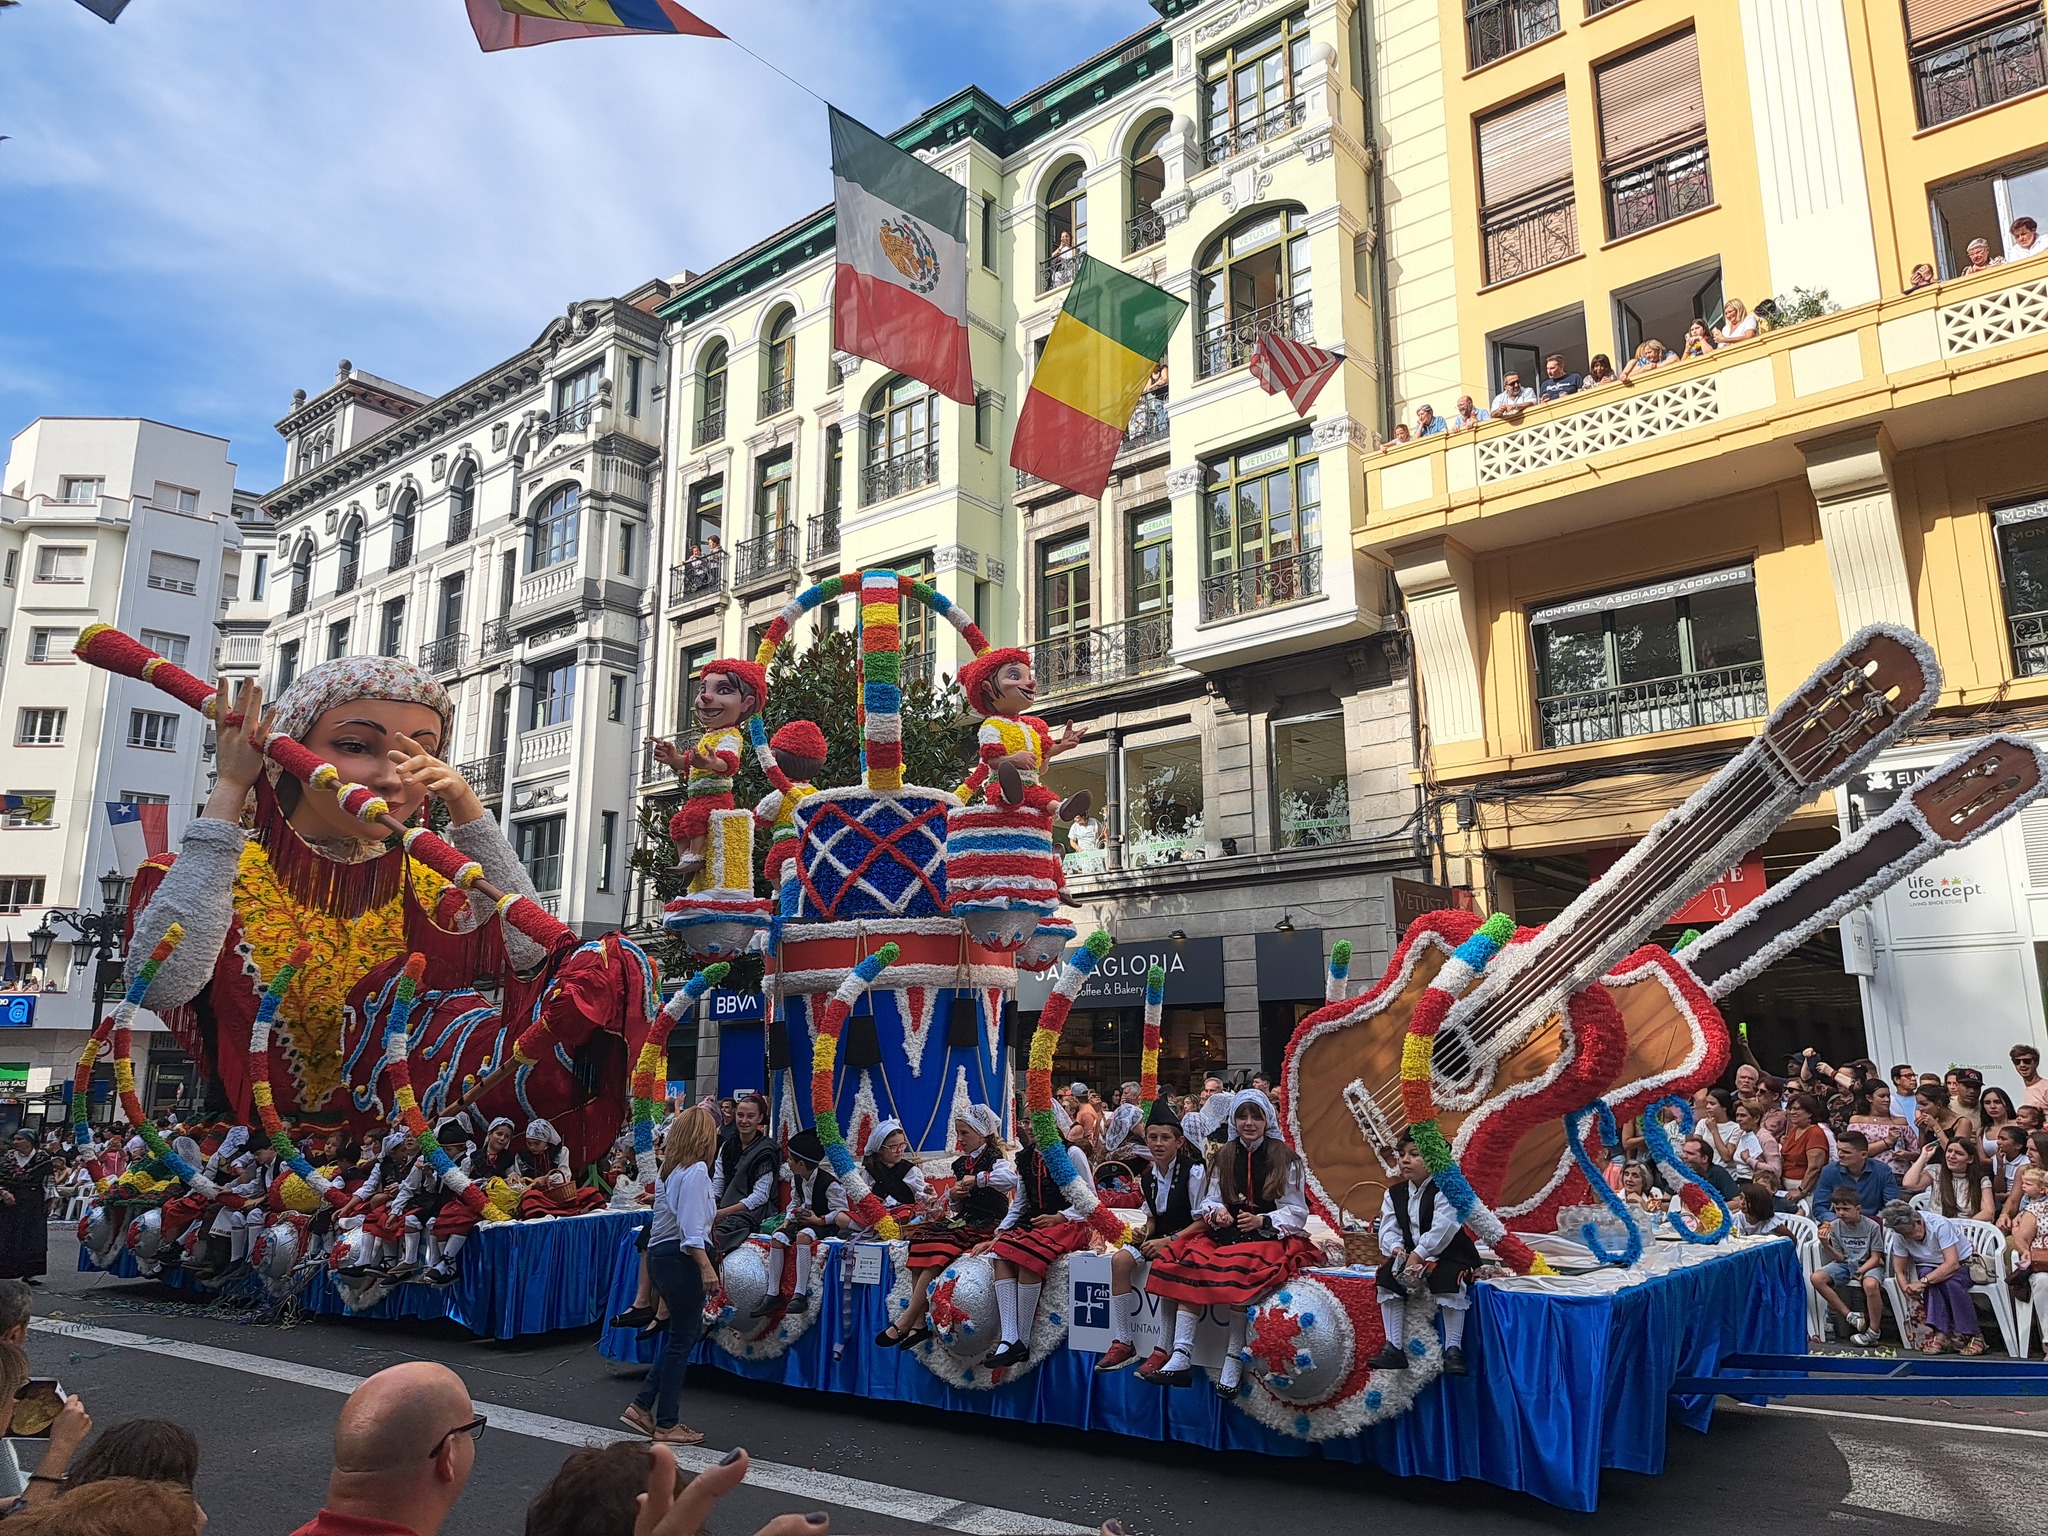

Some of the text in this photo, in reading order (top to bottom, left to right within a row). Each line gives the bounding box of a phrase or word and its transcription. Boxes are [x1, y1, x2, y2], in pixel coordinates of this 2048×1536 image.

[1237, 225, 1276, 246] VETUSTA
[1244, 449, 1284, 467] VETUSTA
[2001, 504, 2048, 521] MONT
[1056, 544, 1088, 559] VETUSTA
[1536, 602, 1590, 619] MONTOTO
[1605, 585, 1675, 605] ASOCIADOS
[1678, 570, 1747, 591] ABOGADOS
[1292, 818, 1340, 829] VETUSTA URIA
[1149, 841, 1173, 851] VETUSTA
[1907, 875, 1934, 889] life
[1395, 888, 1452, 912] VETUSTA
[1908, 883, 1982, 903] concept
[1909, 900, 1928, 908] LIVING
[1928, 899, 1944, 907] SHOE
[1103, 984, 1112, 996] &
[1114, 982, 1145, 997] Bakery
[716, 994, 758, 1014] BBVA
